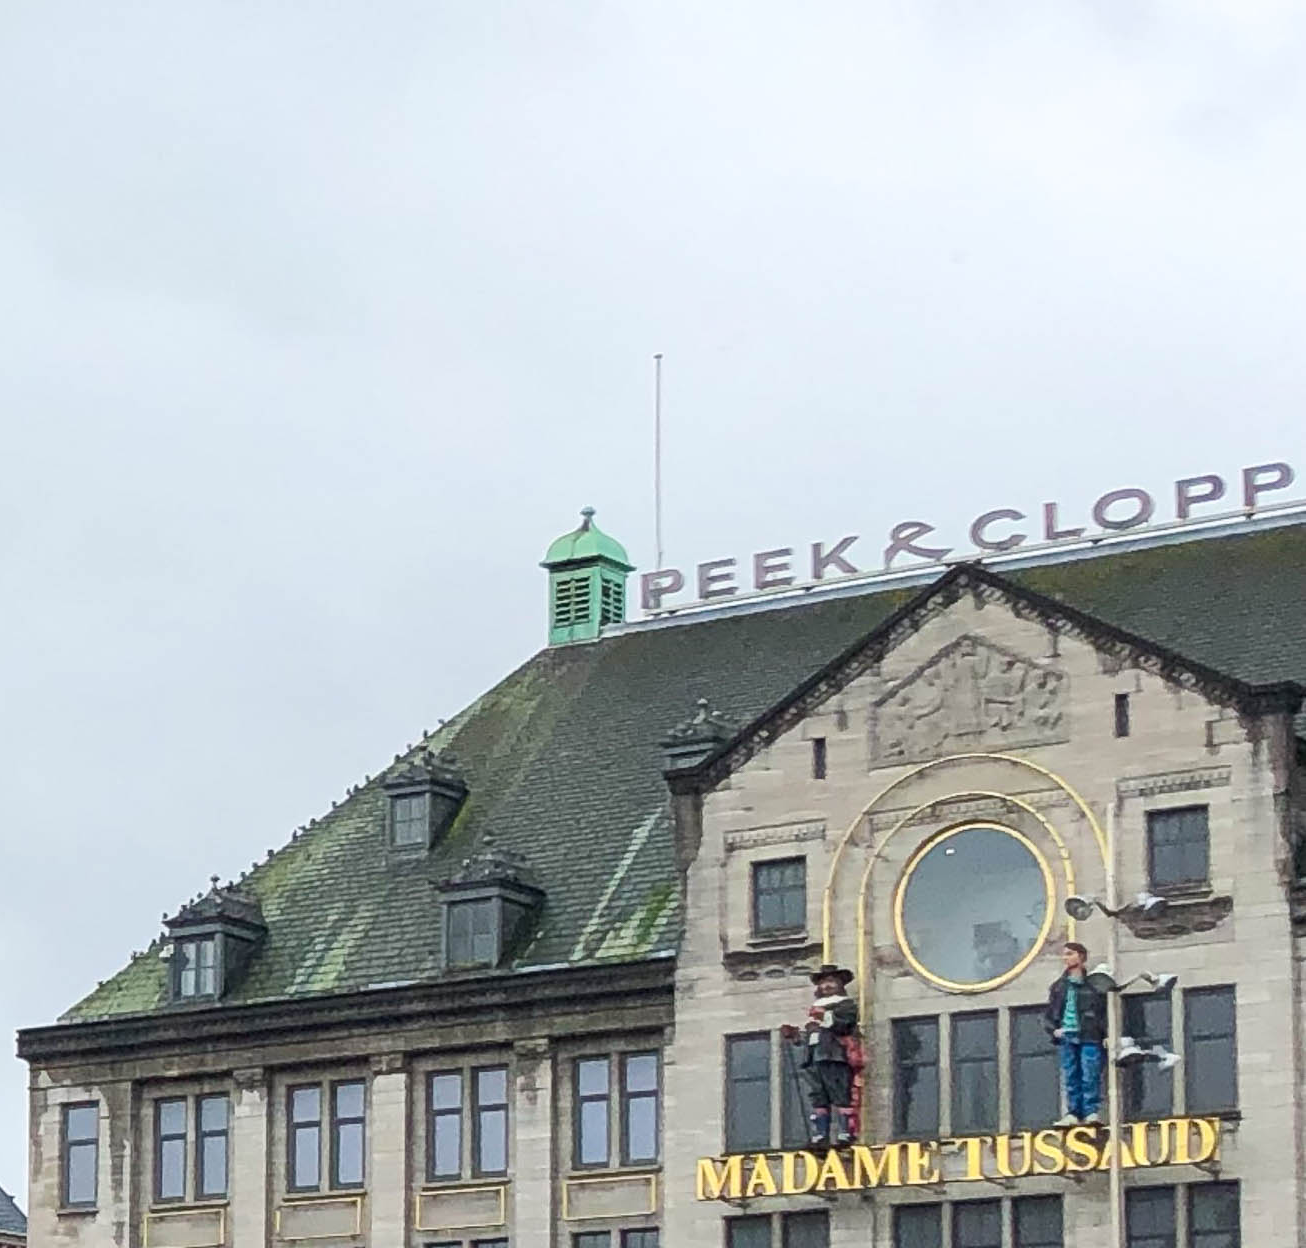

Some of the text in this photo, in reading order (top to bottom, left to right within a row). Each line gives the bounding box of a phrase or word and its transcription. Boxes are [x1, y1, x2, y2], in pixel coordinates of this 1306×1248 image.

[640, 461, 1296, 610] PEEK & CLOPP
[696, 1117, 1218, 1201] MADAME TUSSAUD
